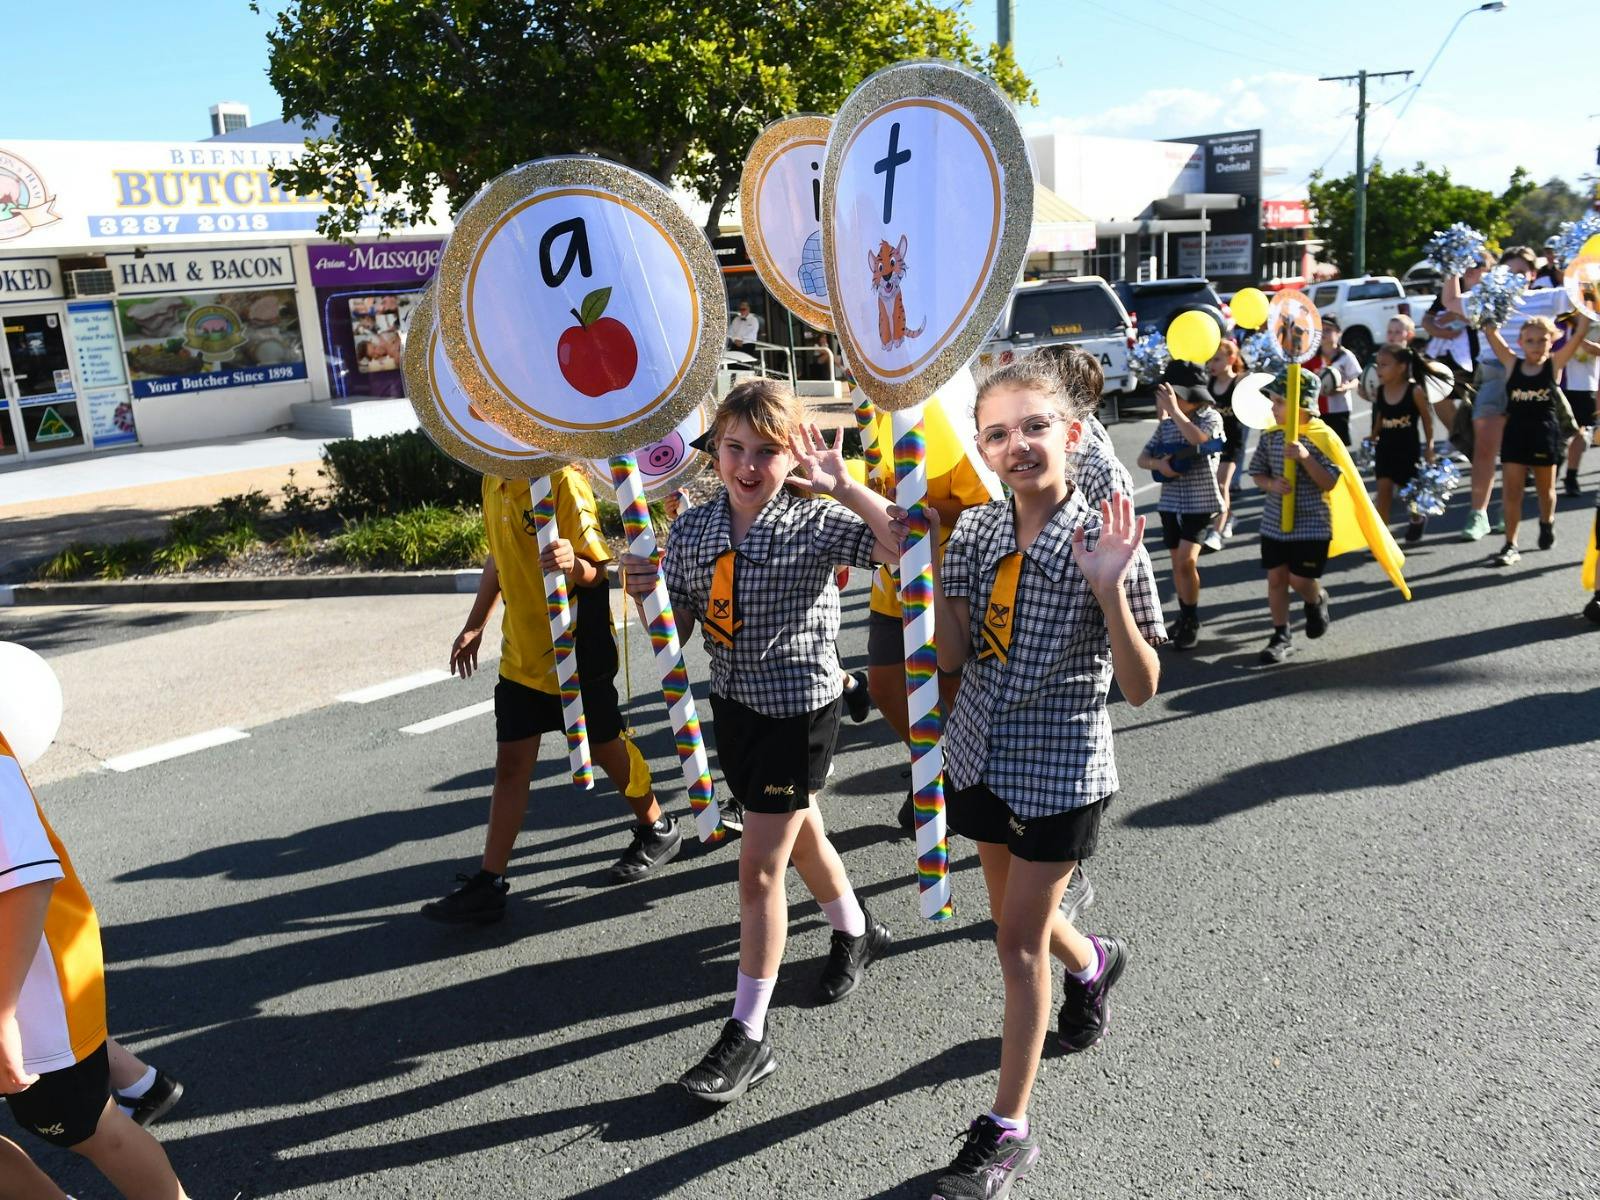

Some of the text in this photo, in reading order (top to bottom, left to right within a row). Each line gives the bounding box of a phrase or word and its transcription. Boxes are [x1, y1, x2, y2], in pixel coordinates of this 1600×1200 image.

[1213, 142, 1254, 156] Medical
[874, 122, 912, 225] t
[1215, 160, 1251, 173] Dental
[810, 161, 821, 222] i
[99, 214, 269, 235] 3287 2018
[347, 246, 440, 276] Massage
[539, 217, 593, 288] a
[0, 268, 52, 292] KED
[119, 257, 283, 284] HAM & BACON
[148, 367, 293, 394] Your Butcher Since 1898
